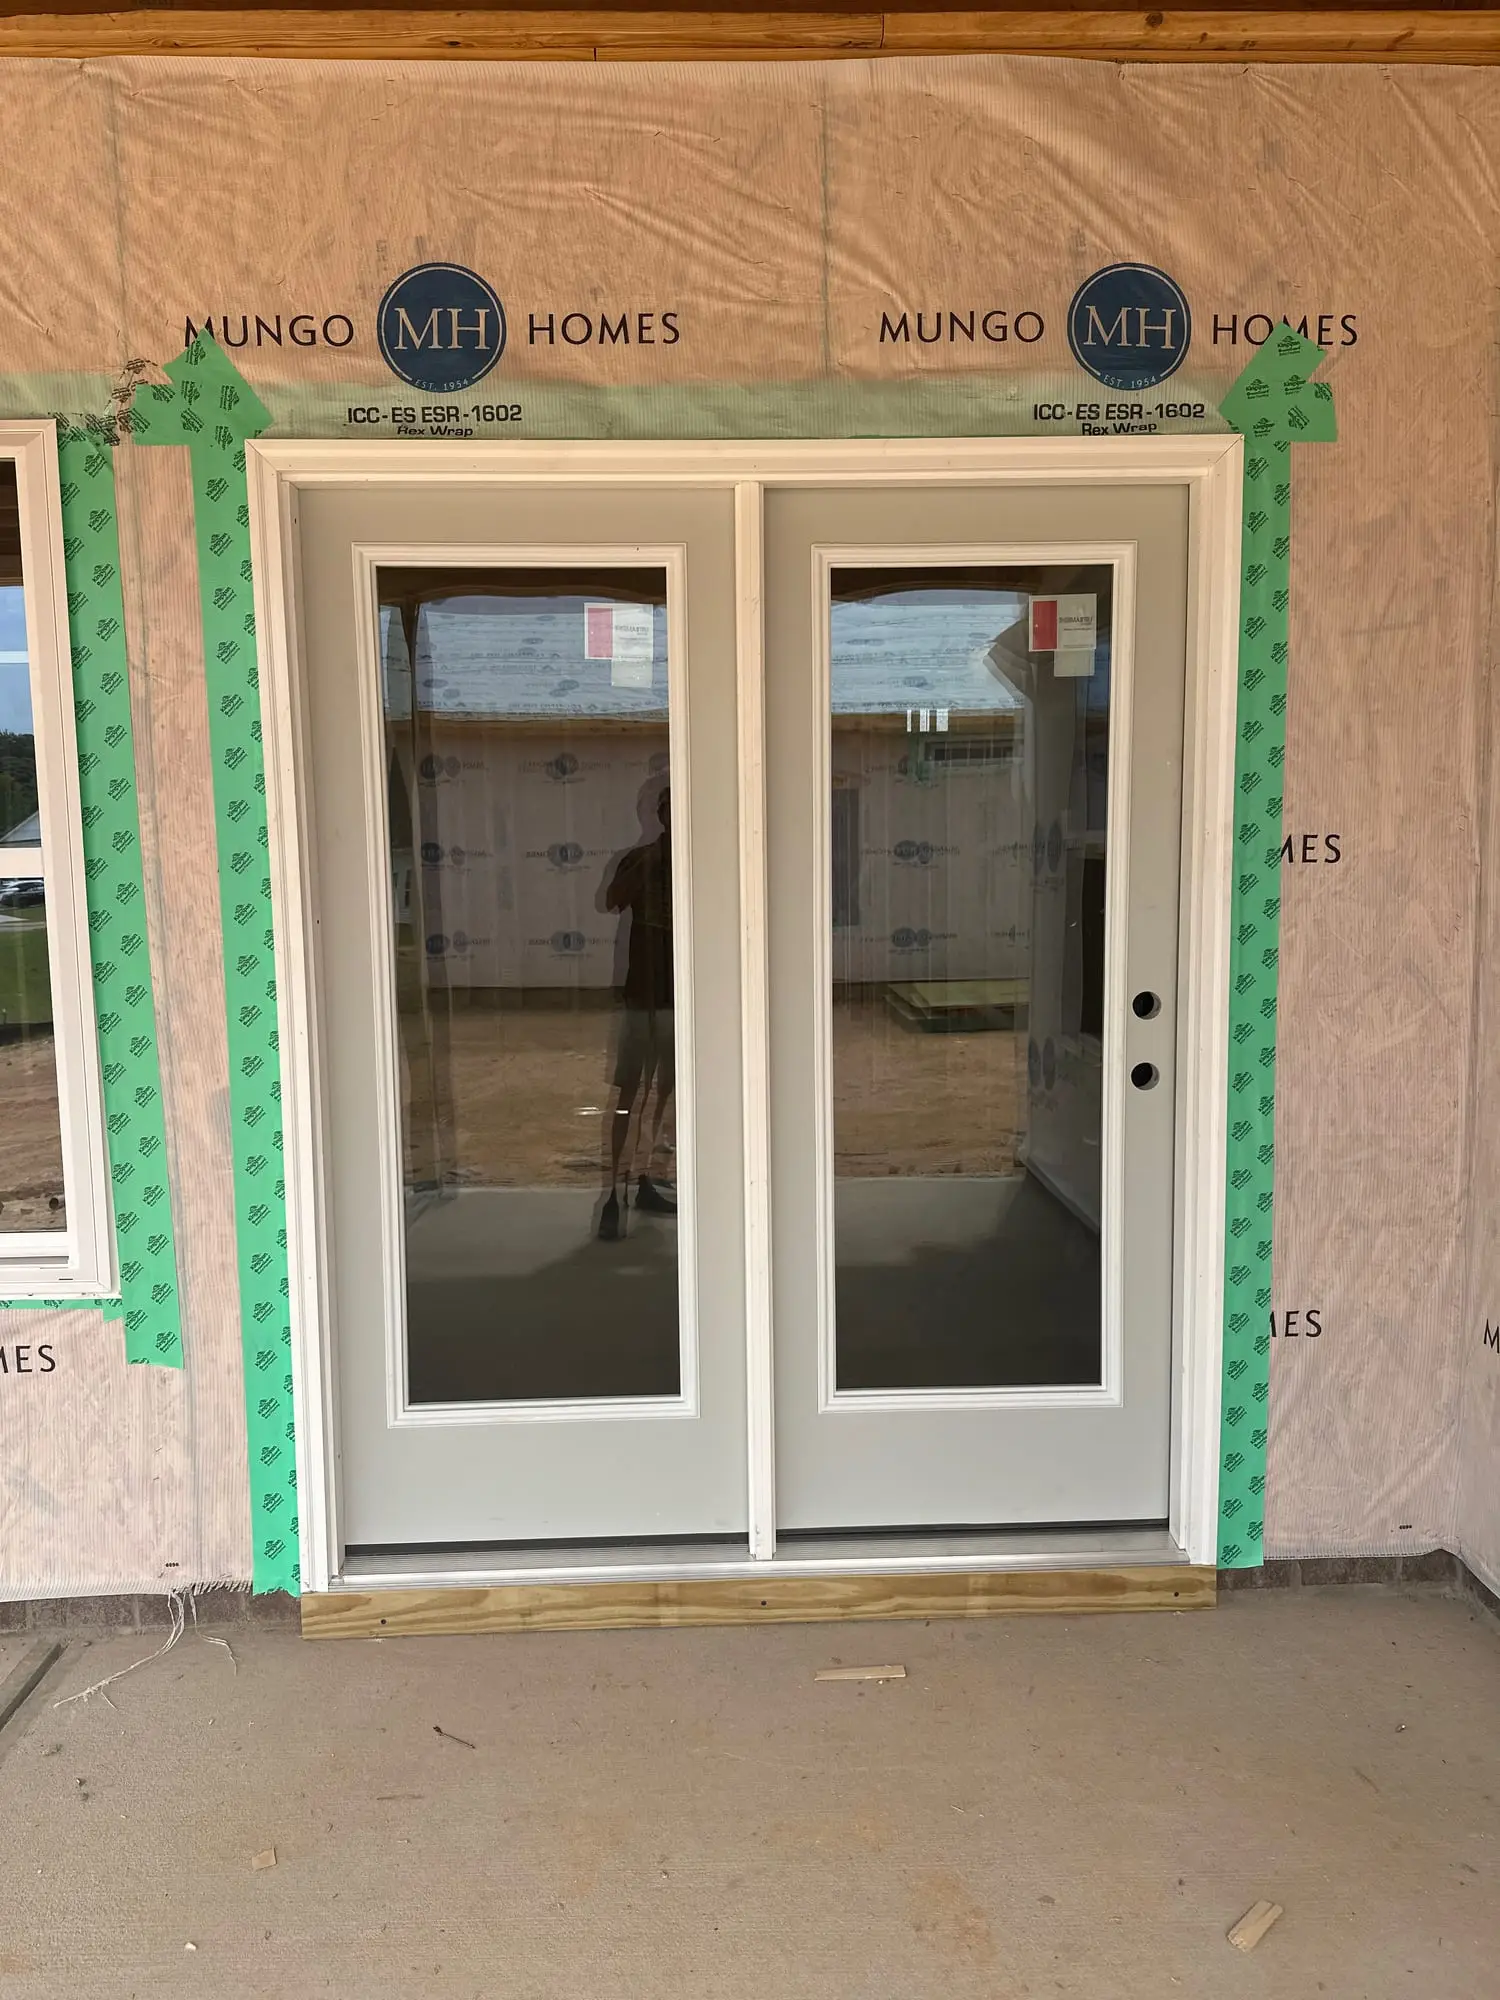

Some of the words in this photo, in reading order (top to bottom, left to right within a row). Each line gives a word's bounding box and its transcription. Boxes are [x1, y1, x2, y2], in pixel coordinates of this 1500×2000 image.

[185, 314, 354, 347] MUNGO
[394, 307, 490, 351] MH
[528, 313, 680, 345] HOMES
[880, 311, 1045, 342] MUNGO
[1084, 305, 1177, 350] MH
[443, 378, 469, 391] 1954
[1131, 375, 1156, 389] 1954
[347, 406, 416, 424] ICC-ES
[421, 404, 522, 424] ESR-1602
[1034, 403, 1100, 420] ICC-ES
[1105, 403, 1205, 420] ESR-1602
[397, 425, 425, 436] Rex
[430, 425, 474, 438] Wrap
[1081, 422, 1109, 436] Rex
[1113, 422, 1158, 434] Wrap
